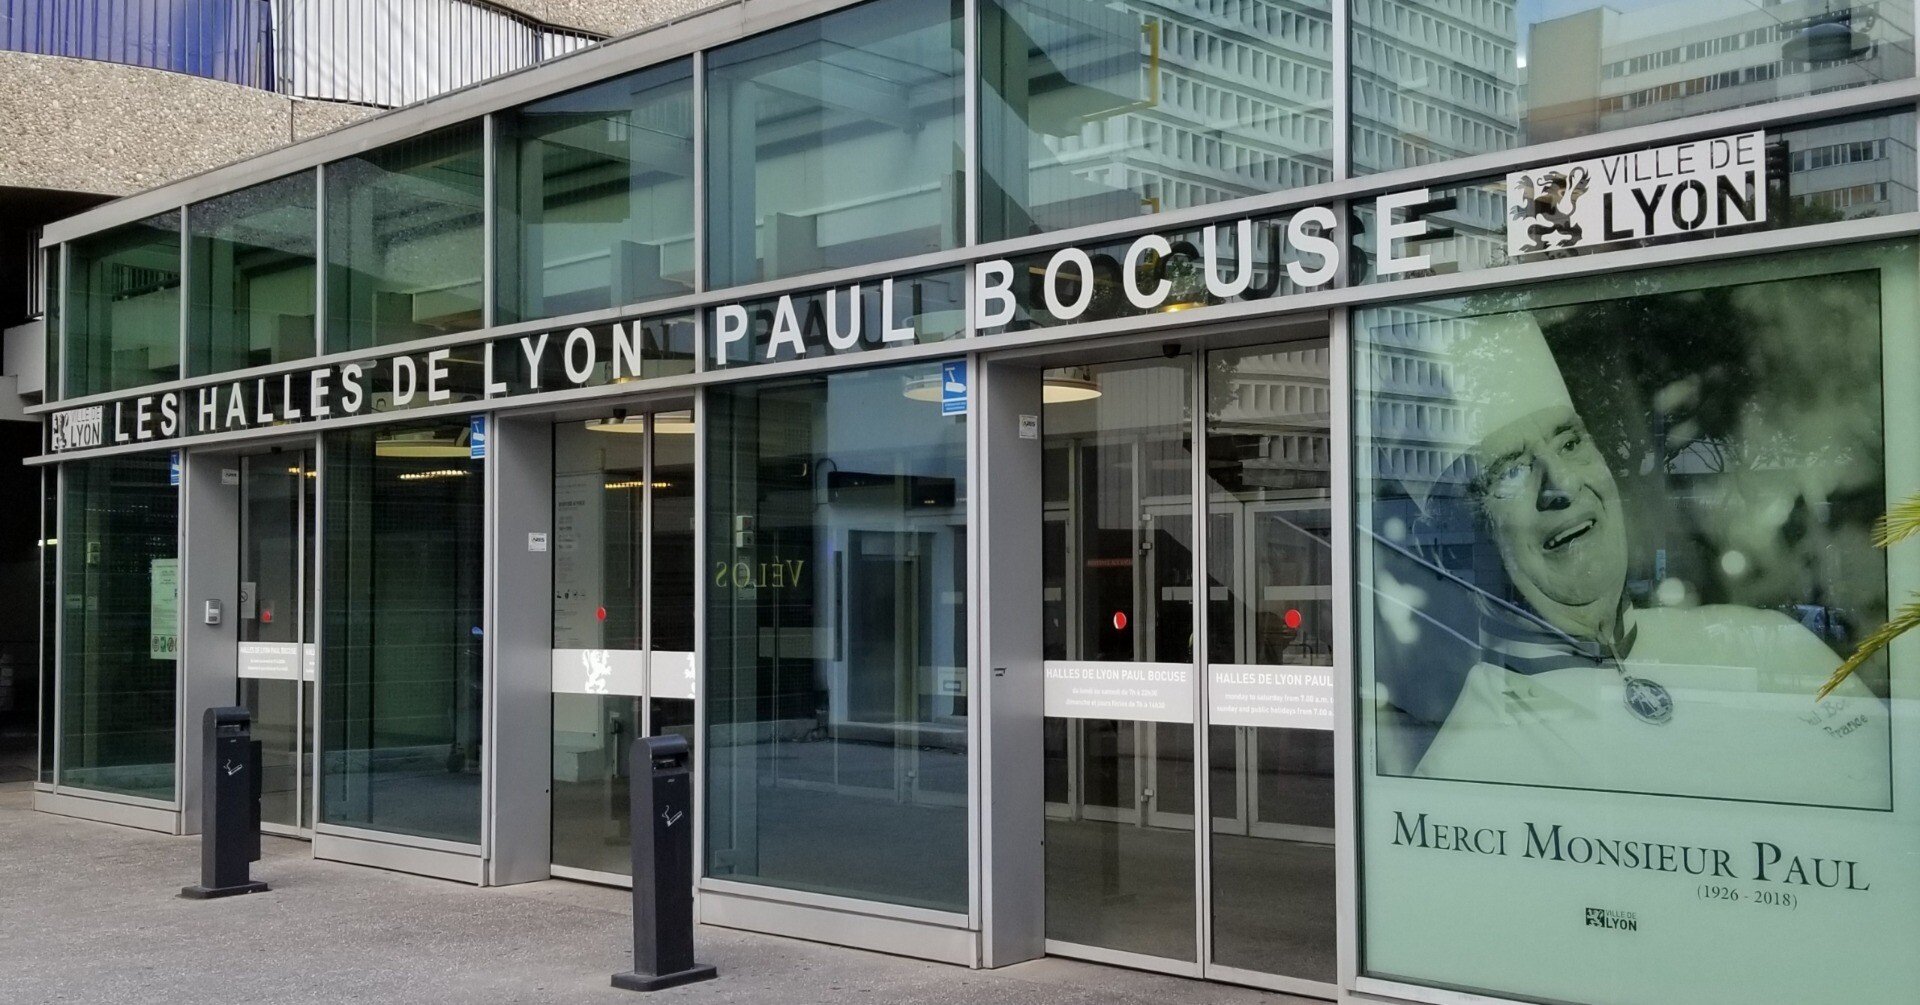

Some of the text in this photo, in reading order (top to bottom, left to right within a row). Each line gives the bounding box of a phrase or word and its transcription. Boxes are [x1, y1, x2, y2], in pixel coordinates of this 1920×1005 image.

[1600, 133, 1755, 186] VILLE DE
[1603, 170, 1756, 242] LYON
[115, 188, 1431, 442] LES HALLES DE LYON PAUL BOCUSE
[70, 421, 100, 447] LYON
[1046, 668, 1187, 682] HALLES DE LYON PAUL BOCUSE
[1216, 672, 1333, 687] HALLES DE LYON PAUL
[1225, 693, 1248, 702] monday
[1284, 694, 1299, 703] from
[1250, 705, 1269, 715] public
[1270, 706, 1296, 717] holidays
[1297, 707, 1312, 716] from
[1823, 714, 1868, 738] France
[1697, 884, 1739, 901] (1926
[1753, 889, 1798, 911] 2018)
[1605, 909, 1637, 920] VILLE DE
[1606, 917, 1637, 931] LYON
